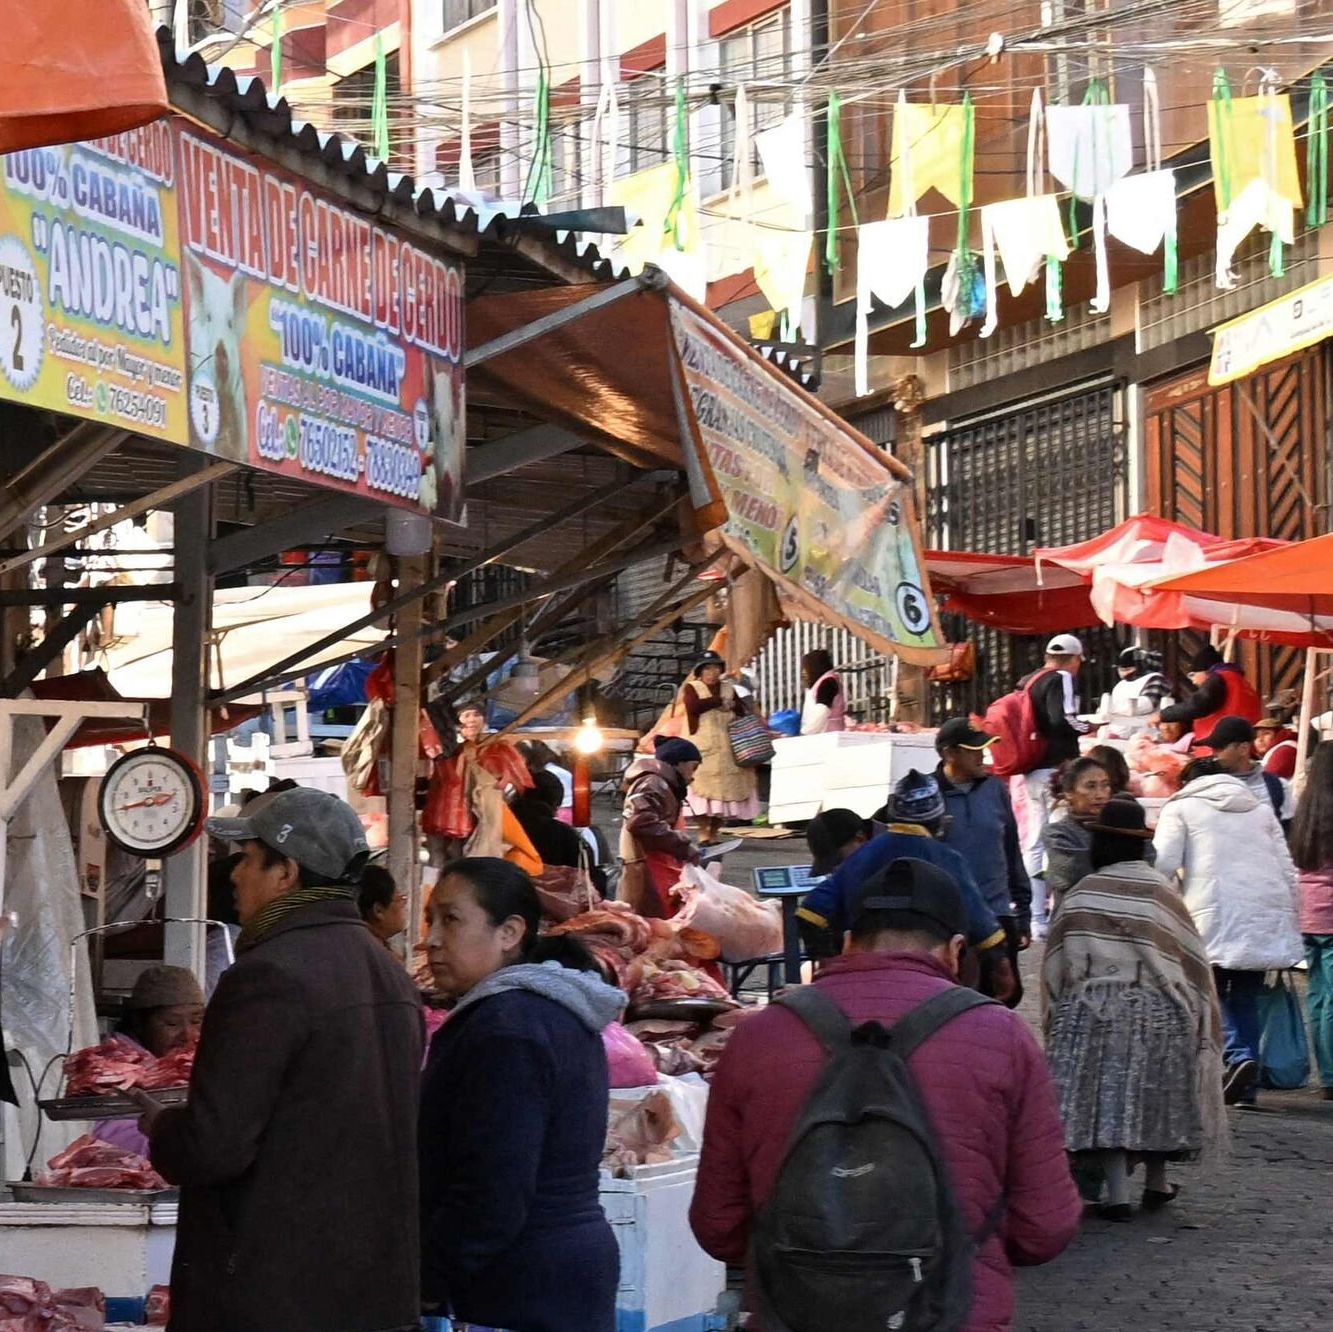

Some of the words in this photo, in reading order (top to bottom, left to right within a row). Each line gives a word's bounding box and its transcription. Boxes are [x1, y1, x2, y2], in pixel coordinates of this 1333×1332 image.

[6, 148, 69, 200] 100%
[72, 162, 161, 239] CABAÑA
[32, 211, 178, 346] "ANDREA"
[181, 130, 266, 280] VENTA
[264, 173, 299, 293] DE
[298, 190, 373, 324] CARNE
[371, 226, 401, 336] DE
[400, 240, 462, 364] CERDO
[11, 304, 24, 372] 2
[109, 384, 167, 429] 76254091
[904, 593, 922, 624] 6
[276, 823, 293, 844] 3
